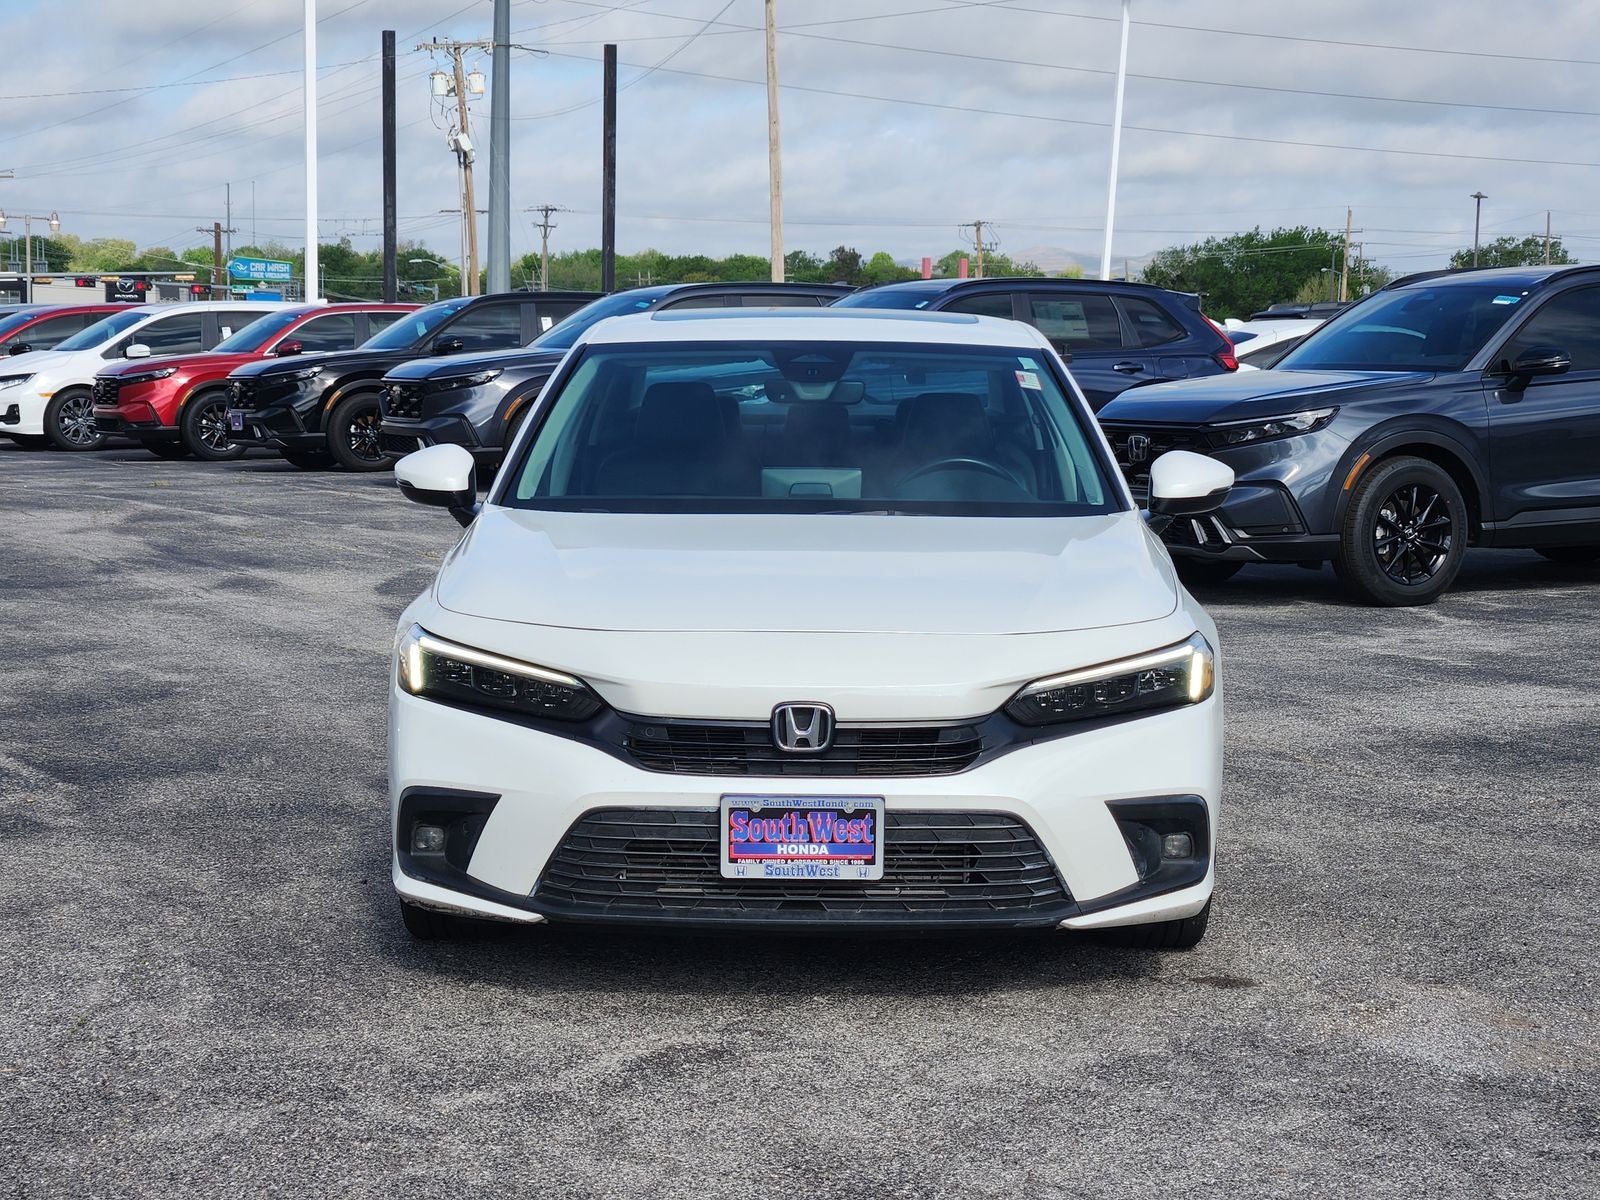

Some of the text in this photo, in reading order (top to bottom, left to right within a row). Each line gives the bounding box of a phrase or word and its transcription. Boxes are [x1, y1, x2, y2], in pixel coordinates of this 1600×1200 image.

[250, 262, 290, 273] CAR WASH
[731, 800, 874, 808] www.SouthWestHondacom
[777, 844, 829, 855] HONDA
[765, 864, 839, 877] SouthWest
